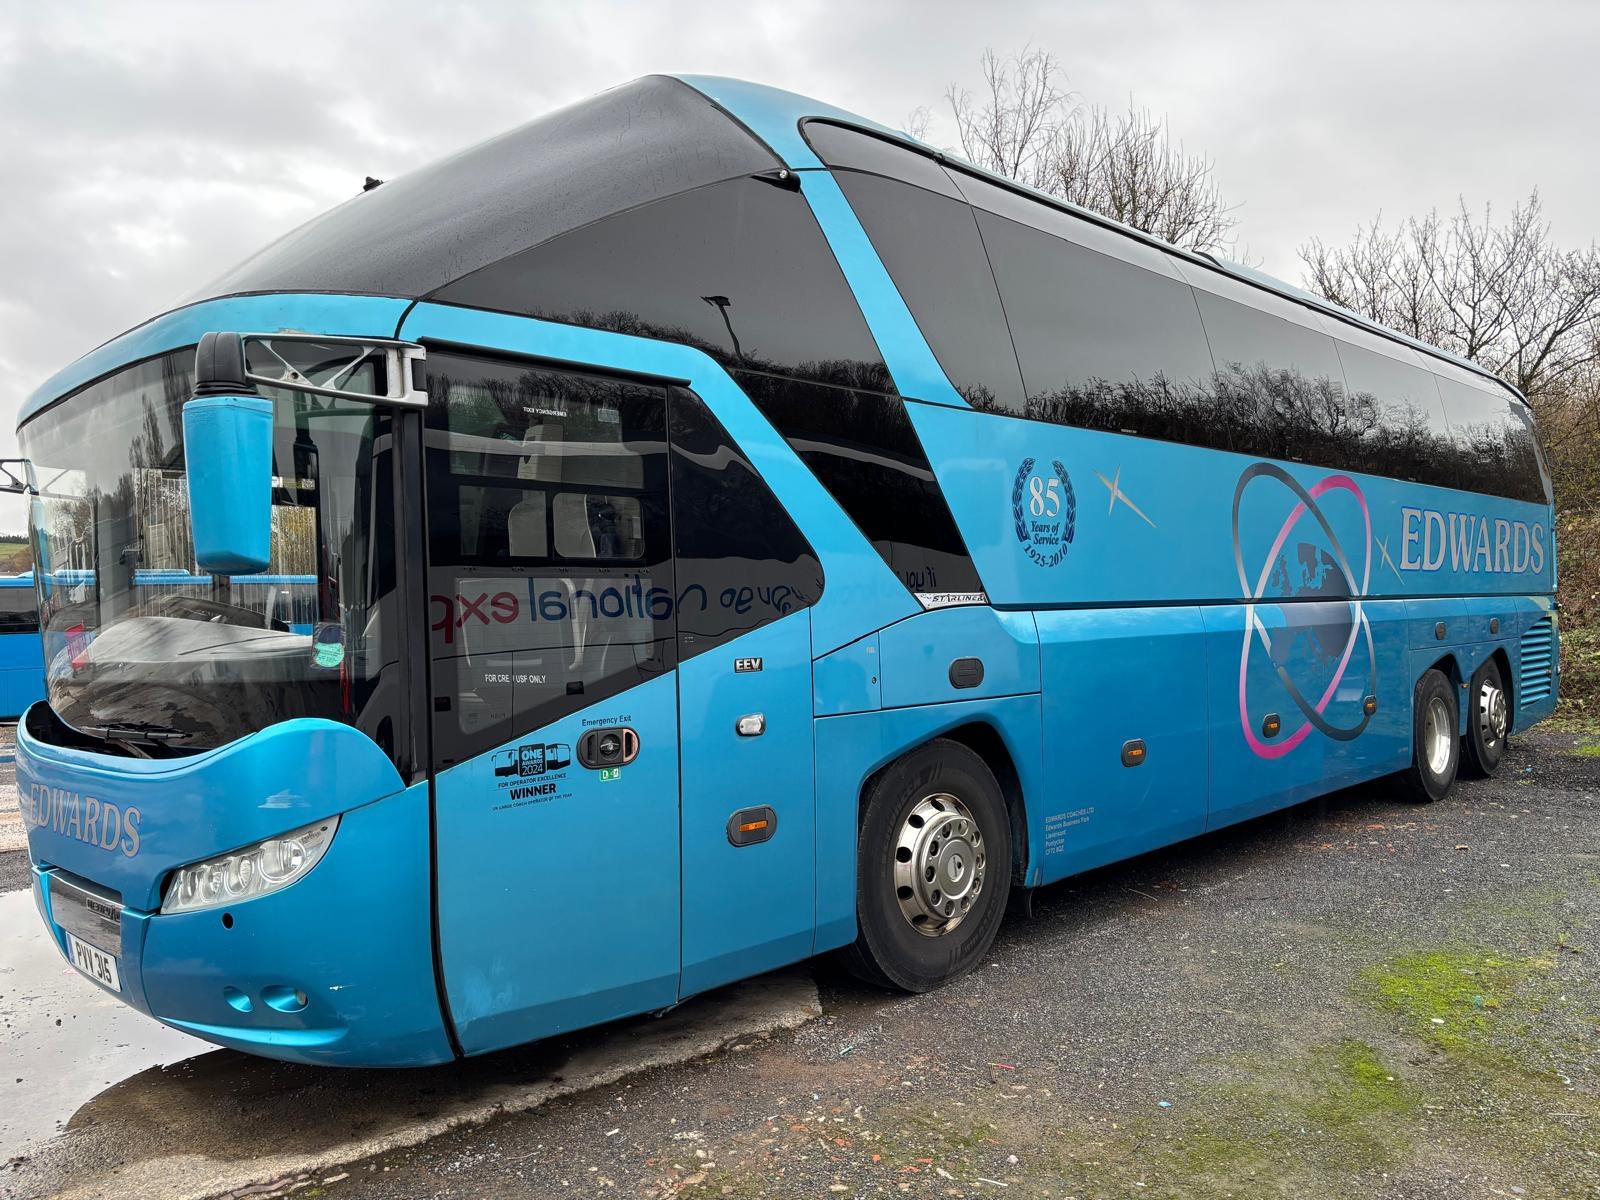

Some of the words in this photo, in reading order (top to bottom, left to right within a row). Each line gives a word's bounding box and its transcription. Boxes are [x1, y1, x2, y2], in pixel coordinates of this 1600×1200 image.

[1029, 476, 1060, 518] 85
[1031, 521, 1050, 533] Years
[1051, 521, 1060, 536] of
[1033, 533, 1060, 545] Service
[1400, 506, 1545, 576] EDWARDS
[1023, 543, 1069, 568] 1925-2010
[735, 658, 762, 671] EEV
[484, 674, 497, 683] FOR
[529, 675, 546, 684] ONLY
[581, 717, 618, 727] Emergency
[619, 715, 632, 723] Exit
[522, 749, 543, 760] ONE
[522, 759, 543, 767] AWARDS
[522, 764, 543, 776] 2024
[510, 777, 536, 787] OPERATOR
[537, 772, 567, 783] EXCELLENCE
[510, 783, 557, 801] WINNER
[29, 783, 141, 858] EDWARDS
[94, 952, 113, 985] 315
